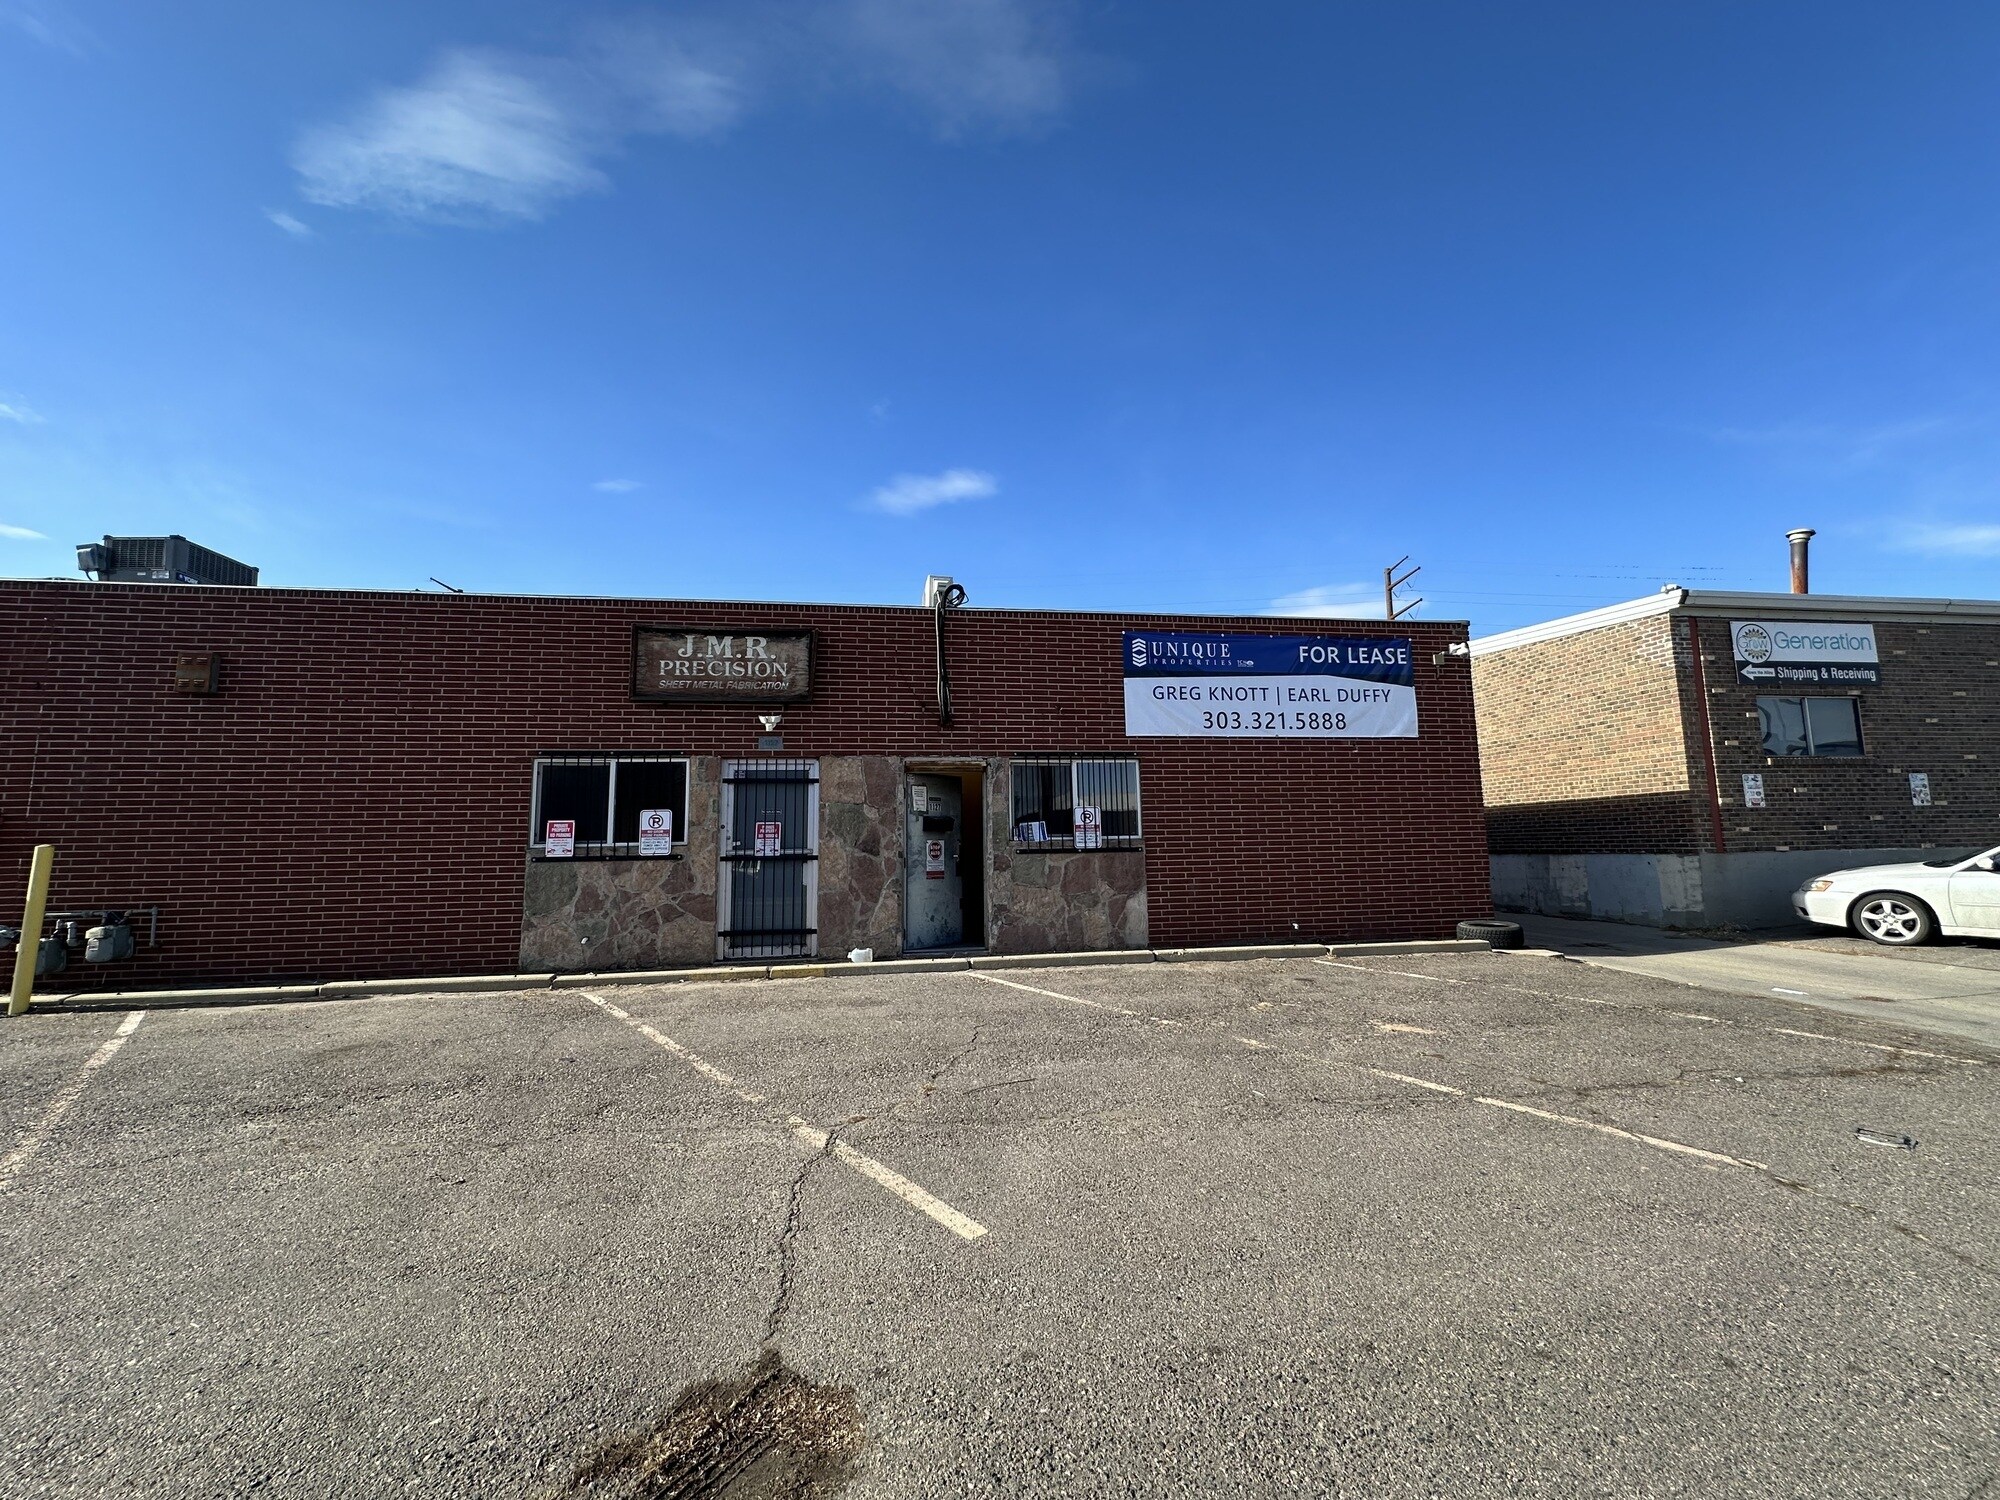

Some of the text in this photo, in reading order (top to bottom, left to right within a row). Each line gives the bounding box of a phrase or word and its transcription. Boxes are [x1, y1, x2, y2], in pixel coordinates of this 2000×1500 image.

[677, 635, 776, 660] J.M.R.
[1774, 630, 1872, 651] Generation
[1152, 641, 1231, 658] UNIQUE
[1299, 646, 1407, 665] FOR LEASE
[659, 659, 788, 677] PRECISION
[1153, 658, 1232, 666] PROPERTIES
[1777, 666, 1876, 682] Shipping & Receiving
[658, 680, 789, 690] SHEET METAL FABRICATION
[1152, 685, 1391, 702] GREG KNOTT EARL DUFFY
[1202, 711, 1347, 730] 303.321.5888
